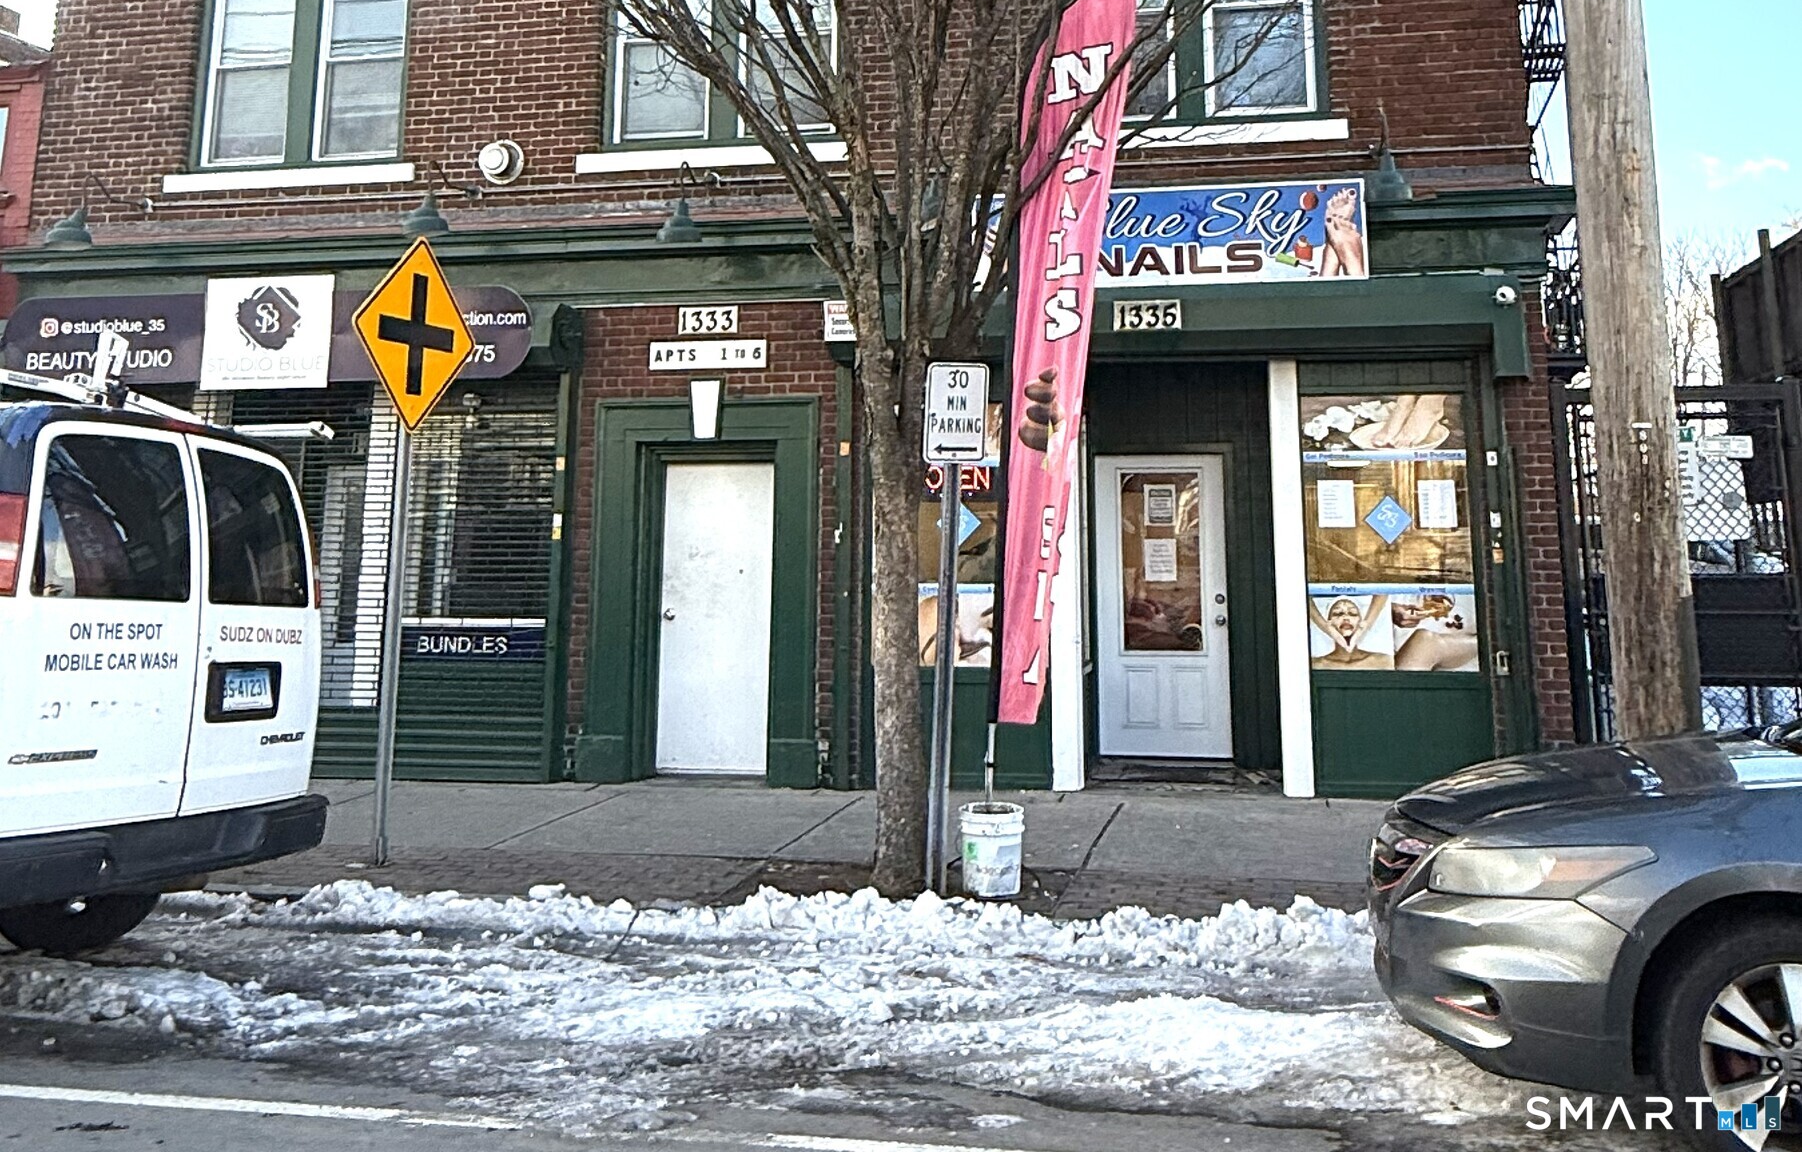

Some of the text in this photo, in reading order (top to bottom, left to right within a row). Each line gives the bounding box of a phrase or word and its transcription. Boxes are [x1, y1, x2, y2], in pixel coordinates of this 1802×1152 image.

[1104, 189, 1308, 256] lue Sky
[1098, 242, 1263, 277] NAILS
[681, 309, 734, 333] 1333
[1118, 304, 1179, 329] 1335
[60, 318, 166, 336] @studioblue_35
[26, 349, 173, 371] BEAUTY UDIO
[206, 355, 325, 373] STUDIO BLUE
[654, 347, 762, 362] APTS 1 TO 6
[948, 370, 969, 389] 30
[946, 395, 967, 411] MIN
[931, 417, 982, 434] PARKING
[924, 466, 990, 490] OEN
[69, 622, 163, 640] ON THE SPOT
[220, 625, 303, 645] SUDZ ON DUBZ
[416, 635, 508, 655] BUNDLES
[44, 652, 179, 672] MOBILE CAR WASH
